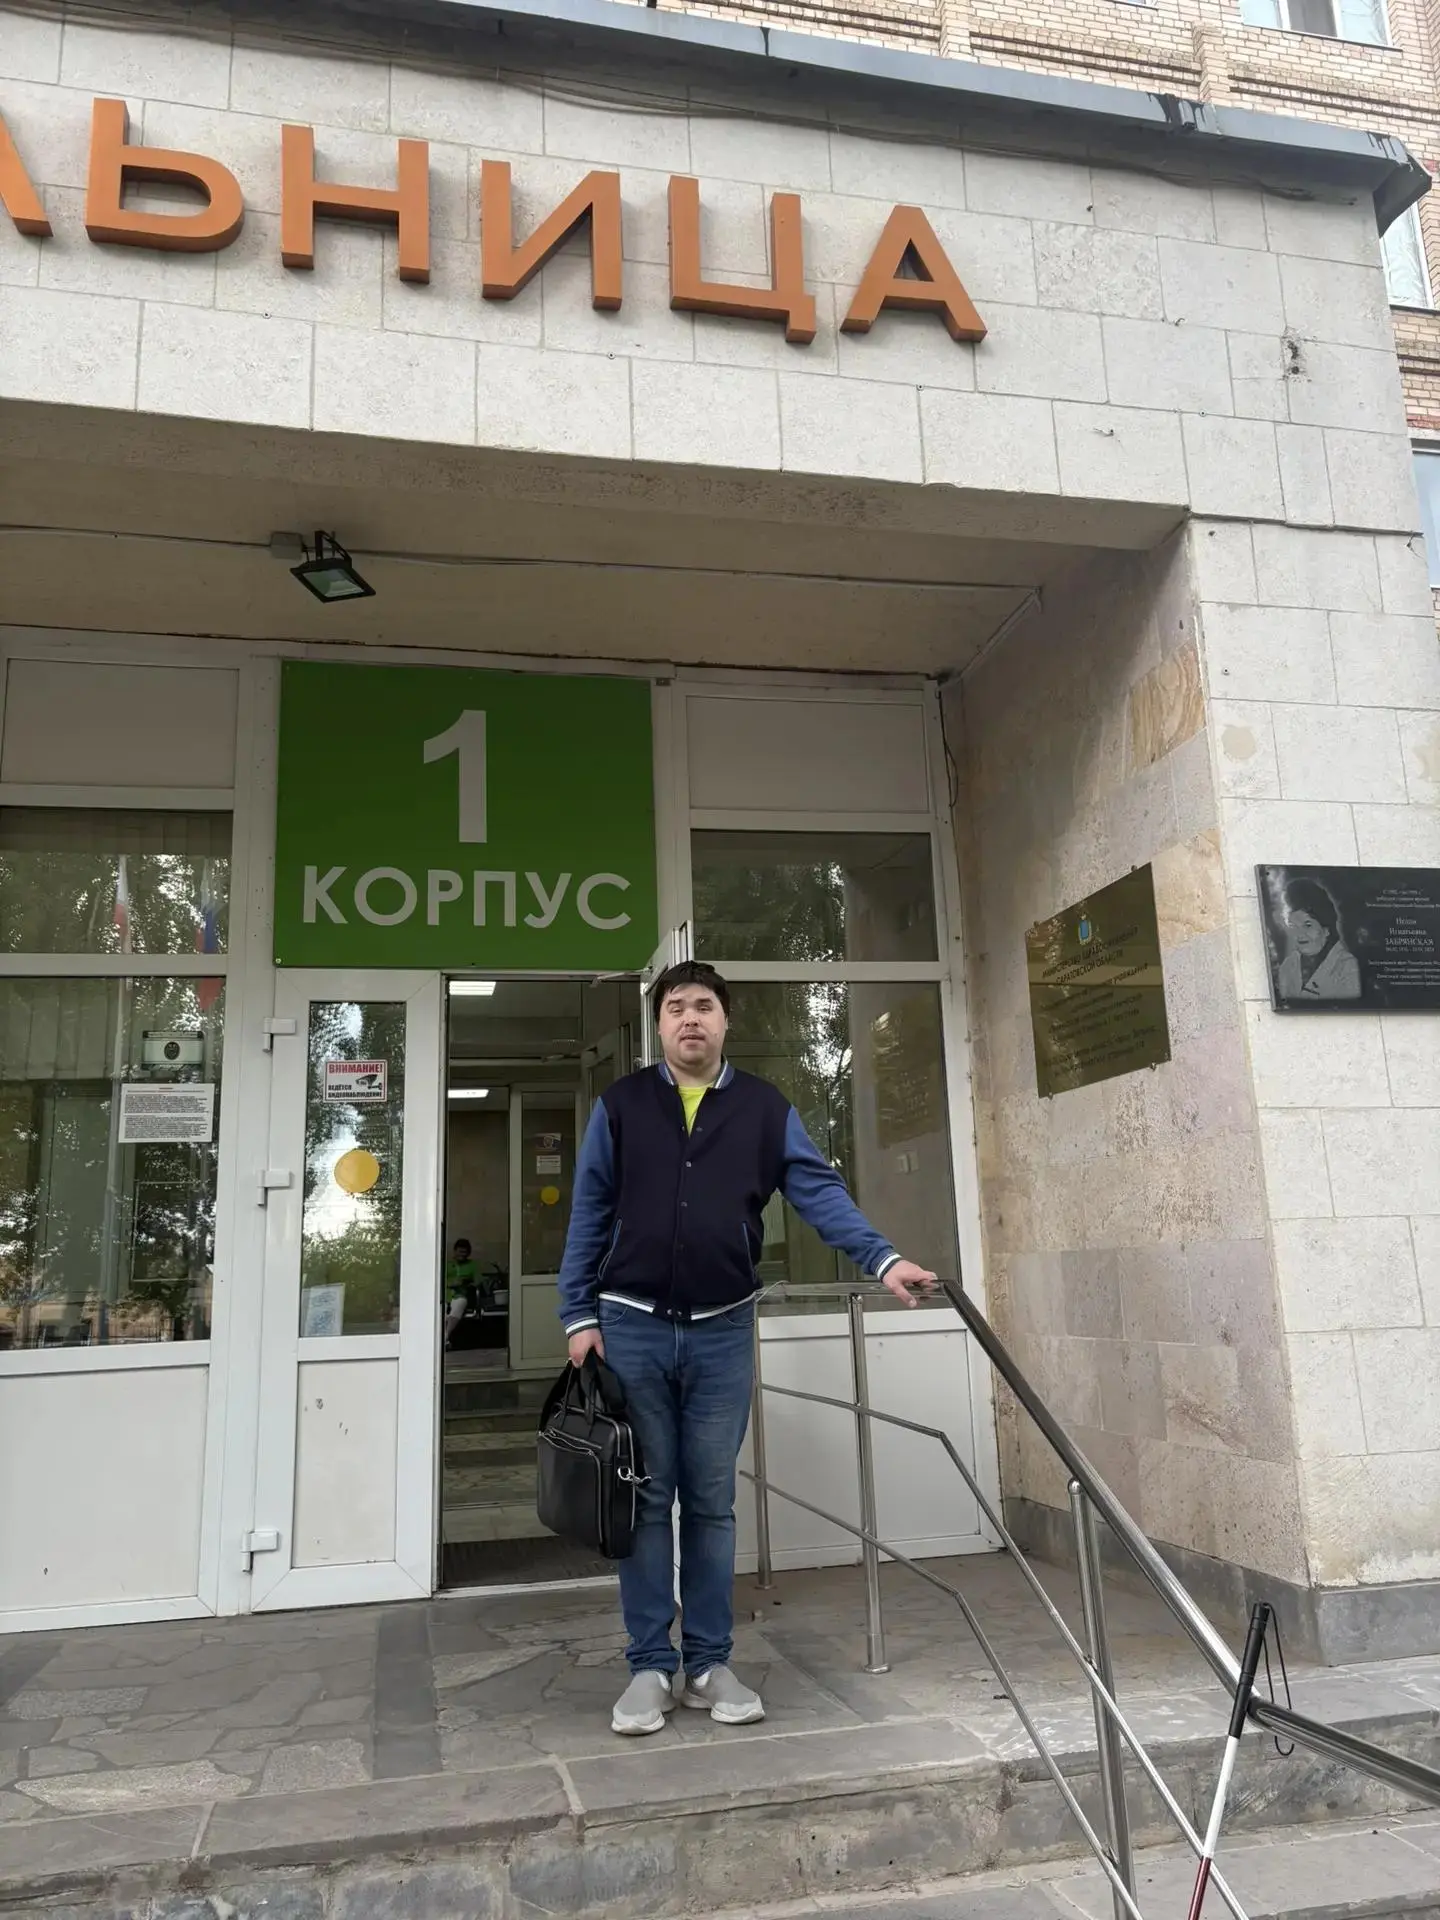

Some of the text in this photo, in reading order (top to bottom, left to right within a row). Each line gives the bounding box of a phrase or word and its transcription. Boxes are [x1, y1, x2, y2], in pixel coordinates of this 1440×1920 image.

[423, 708, 488, 844] 1
[302, 864, 632, 930] КОРПУС
[1056, 961, 1096, 985] САРАТОВСКОЙ
[328, 1064, 383, 1074] ВНИМАНИЕ!
